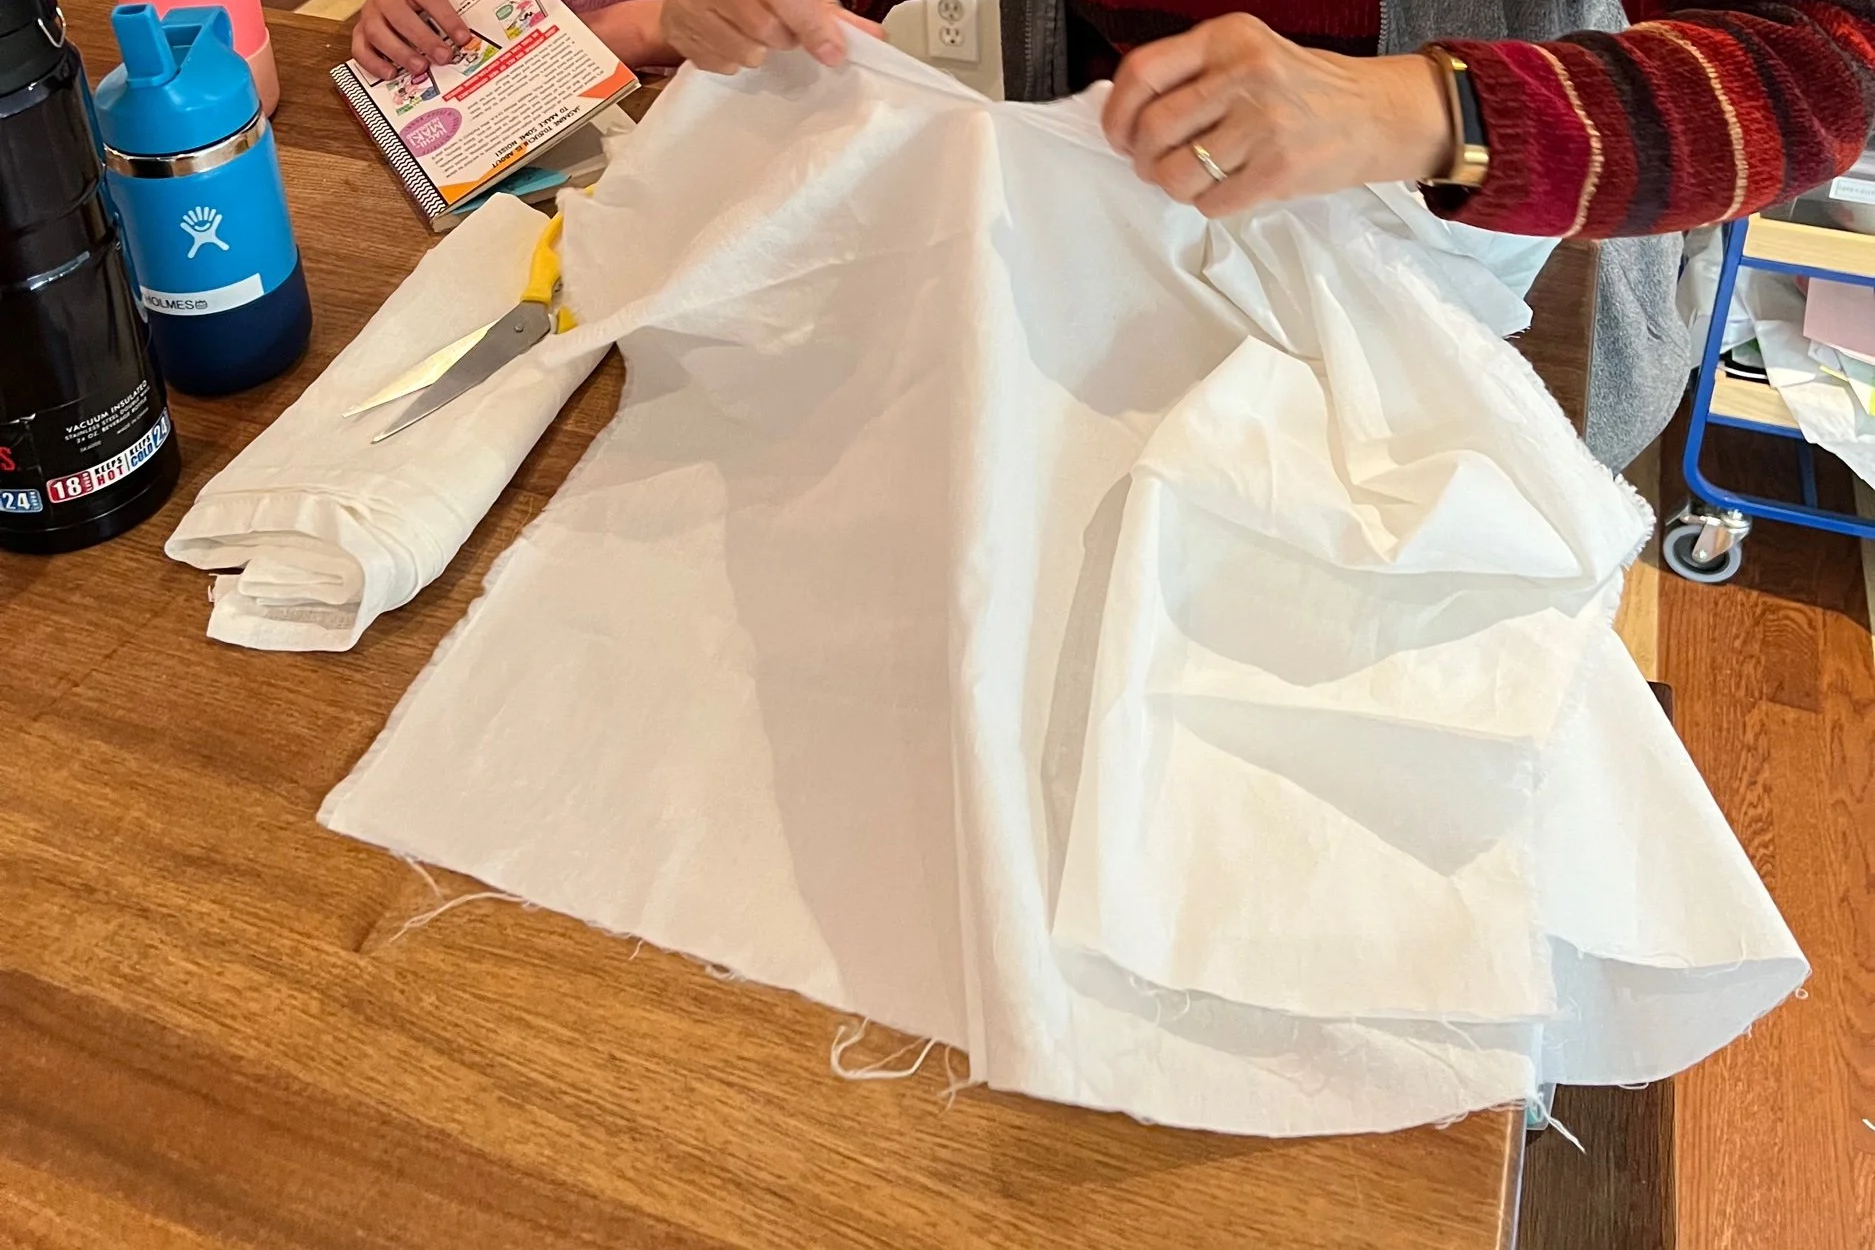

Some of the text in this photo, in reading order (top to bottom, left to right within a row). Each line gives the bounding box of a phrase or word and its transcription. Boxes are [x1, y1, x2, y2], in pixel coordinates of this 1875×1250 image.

[407, 119, 445, 147] MAKI
[413, 126, 448, 151] HACHI-
[66, 380, 147, 433] VACUUM INSULATED
[130, 435, 151, 456] KEEPS
[131, 443, 153, 467] COLD
[95, 456, 123, 475] KEEPS
[97, 465, 124, 486] HOT
[52, 477, 82, 499] 18
[2, 492, 31, 510] 24
